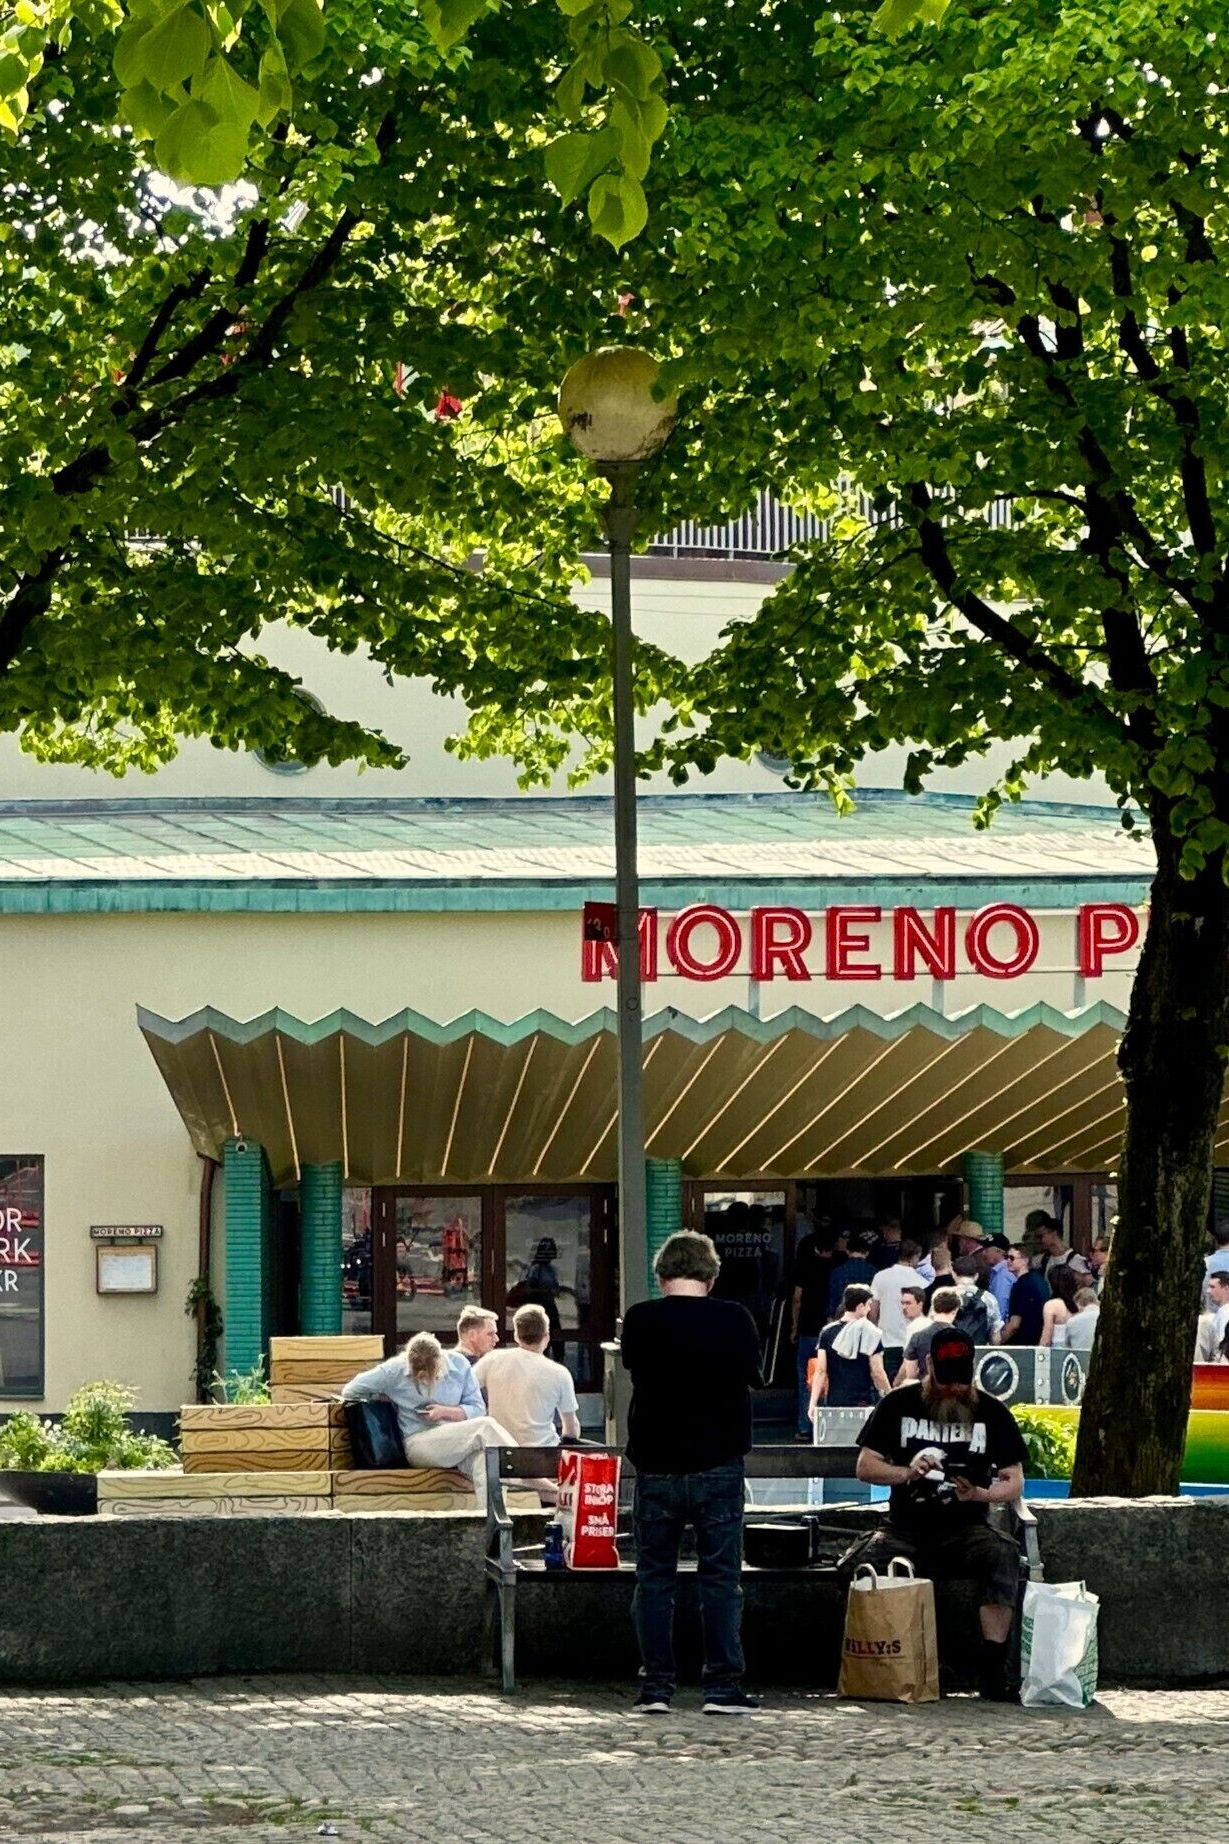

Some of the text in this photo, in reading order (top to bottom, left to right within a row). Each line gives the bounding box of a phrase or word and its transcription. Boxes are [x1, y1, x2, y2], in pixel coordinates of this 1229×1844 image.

[582, 903, 1039, 982] MORENO
[715, 1233, 771, 1244] MORENO
[725, 1246, 763, 1257] PIZZA
[584, 1483, 614, 1494] STORA
[580, 1525, 615, 1537] PRISER
